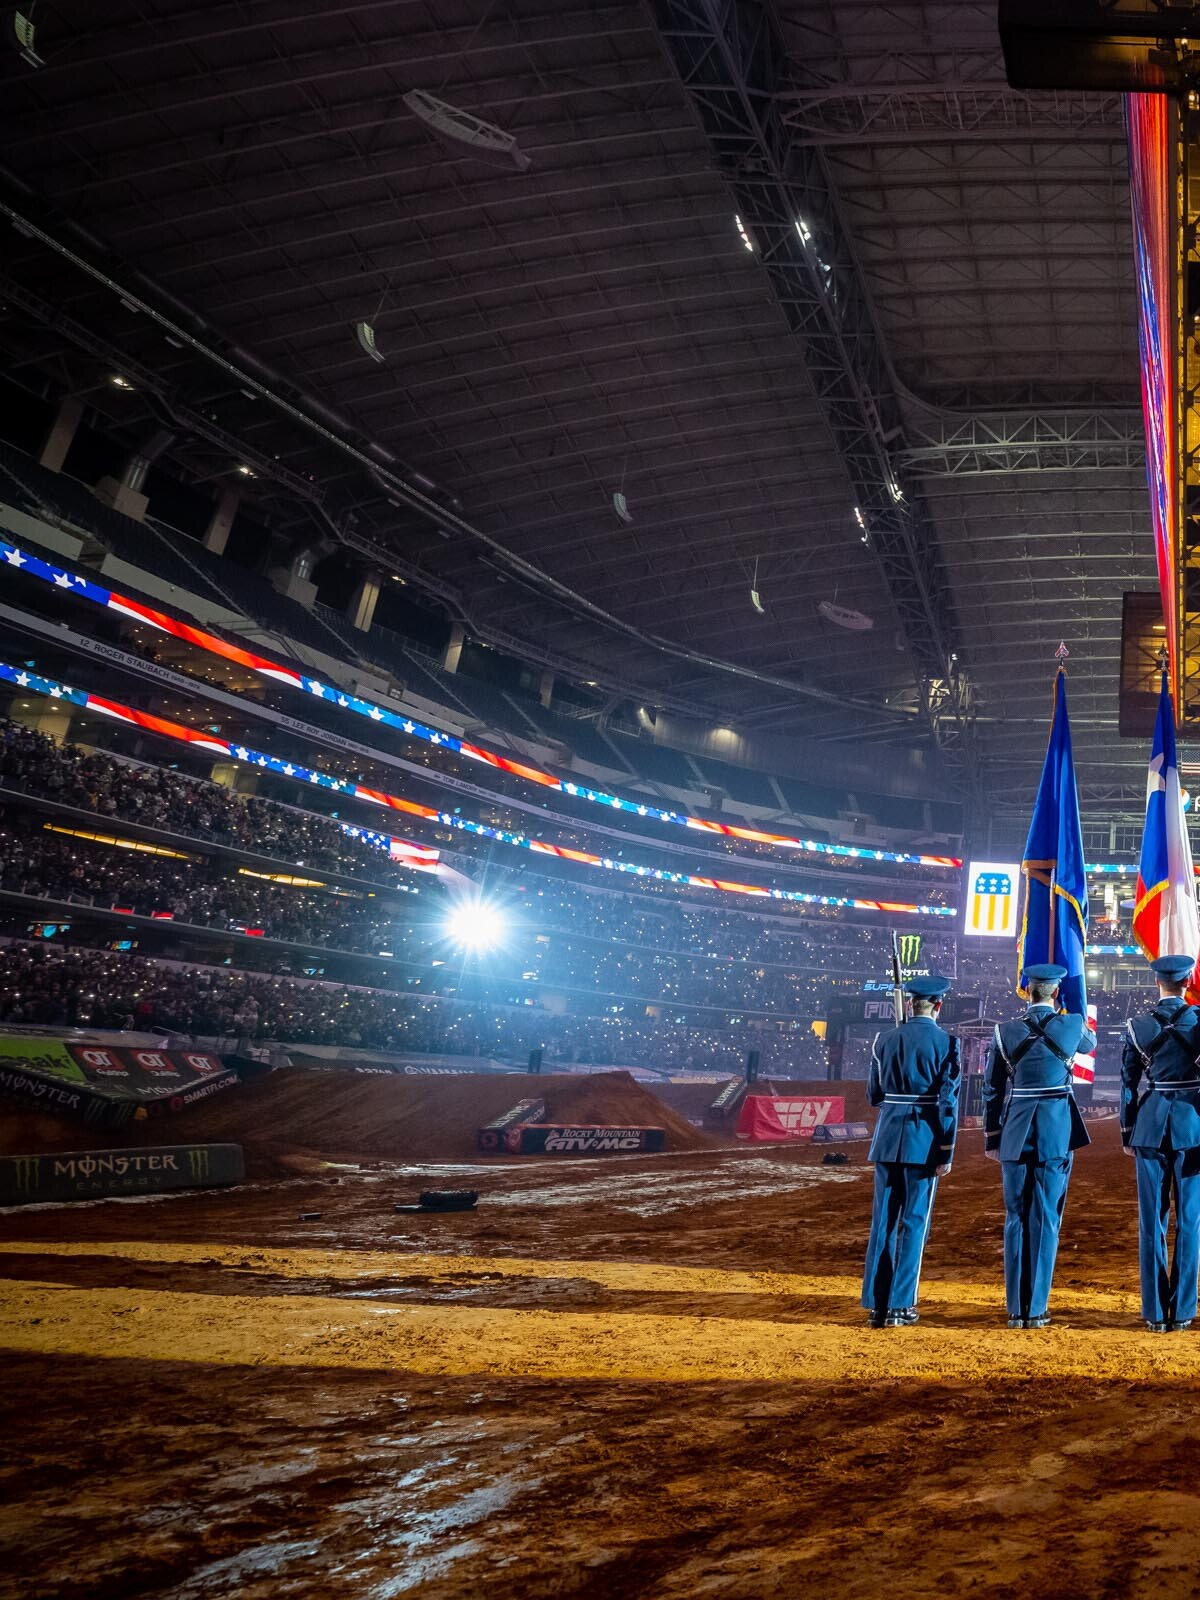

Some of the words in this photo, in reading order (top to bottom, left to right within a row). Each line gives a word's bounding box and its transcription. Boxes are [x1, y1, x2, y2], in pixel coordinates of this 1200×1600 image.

[79, 638, 90, 647] 12
[94, 643, 125, 661] ROGER
[126, 658, 170, 679] STAUBACH
[885, 968, 930, 977] MNSTER
[82, 1050, 113, 1066] QT
[137, 1052, 167, 1068] QT
[187, 1055, 213, 1071] QT
[773, 1101, 833, 1129] FLY
[562, 1128, 594, 1138] ROCKY
[594, 1128, 641, 1138] MOUNTAIN
[54, 1154, 180, 1180] MONSTER
